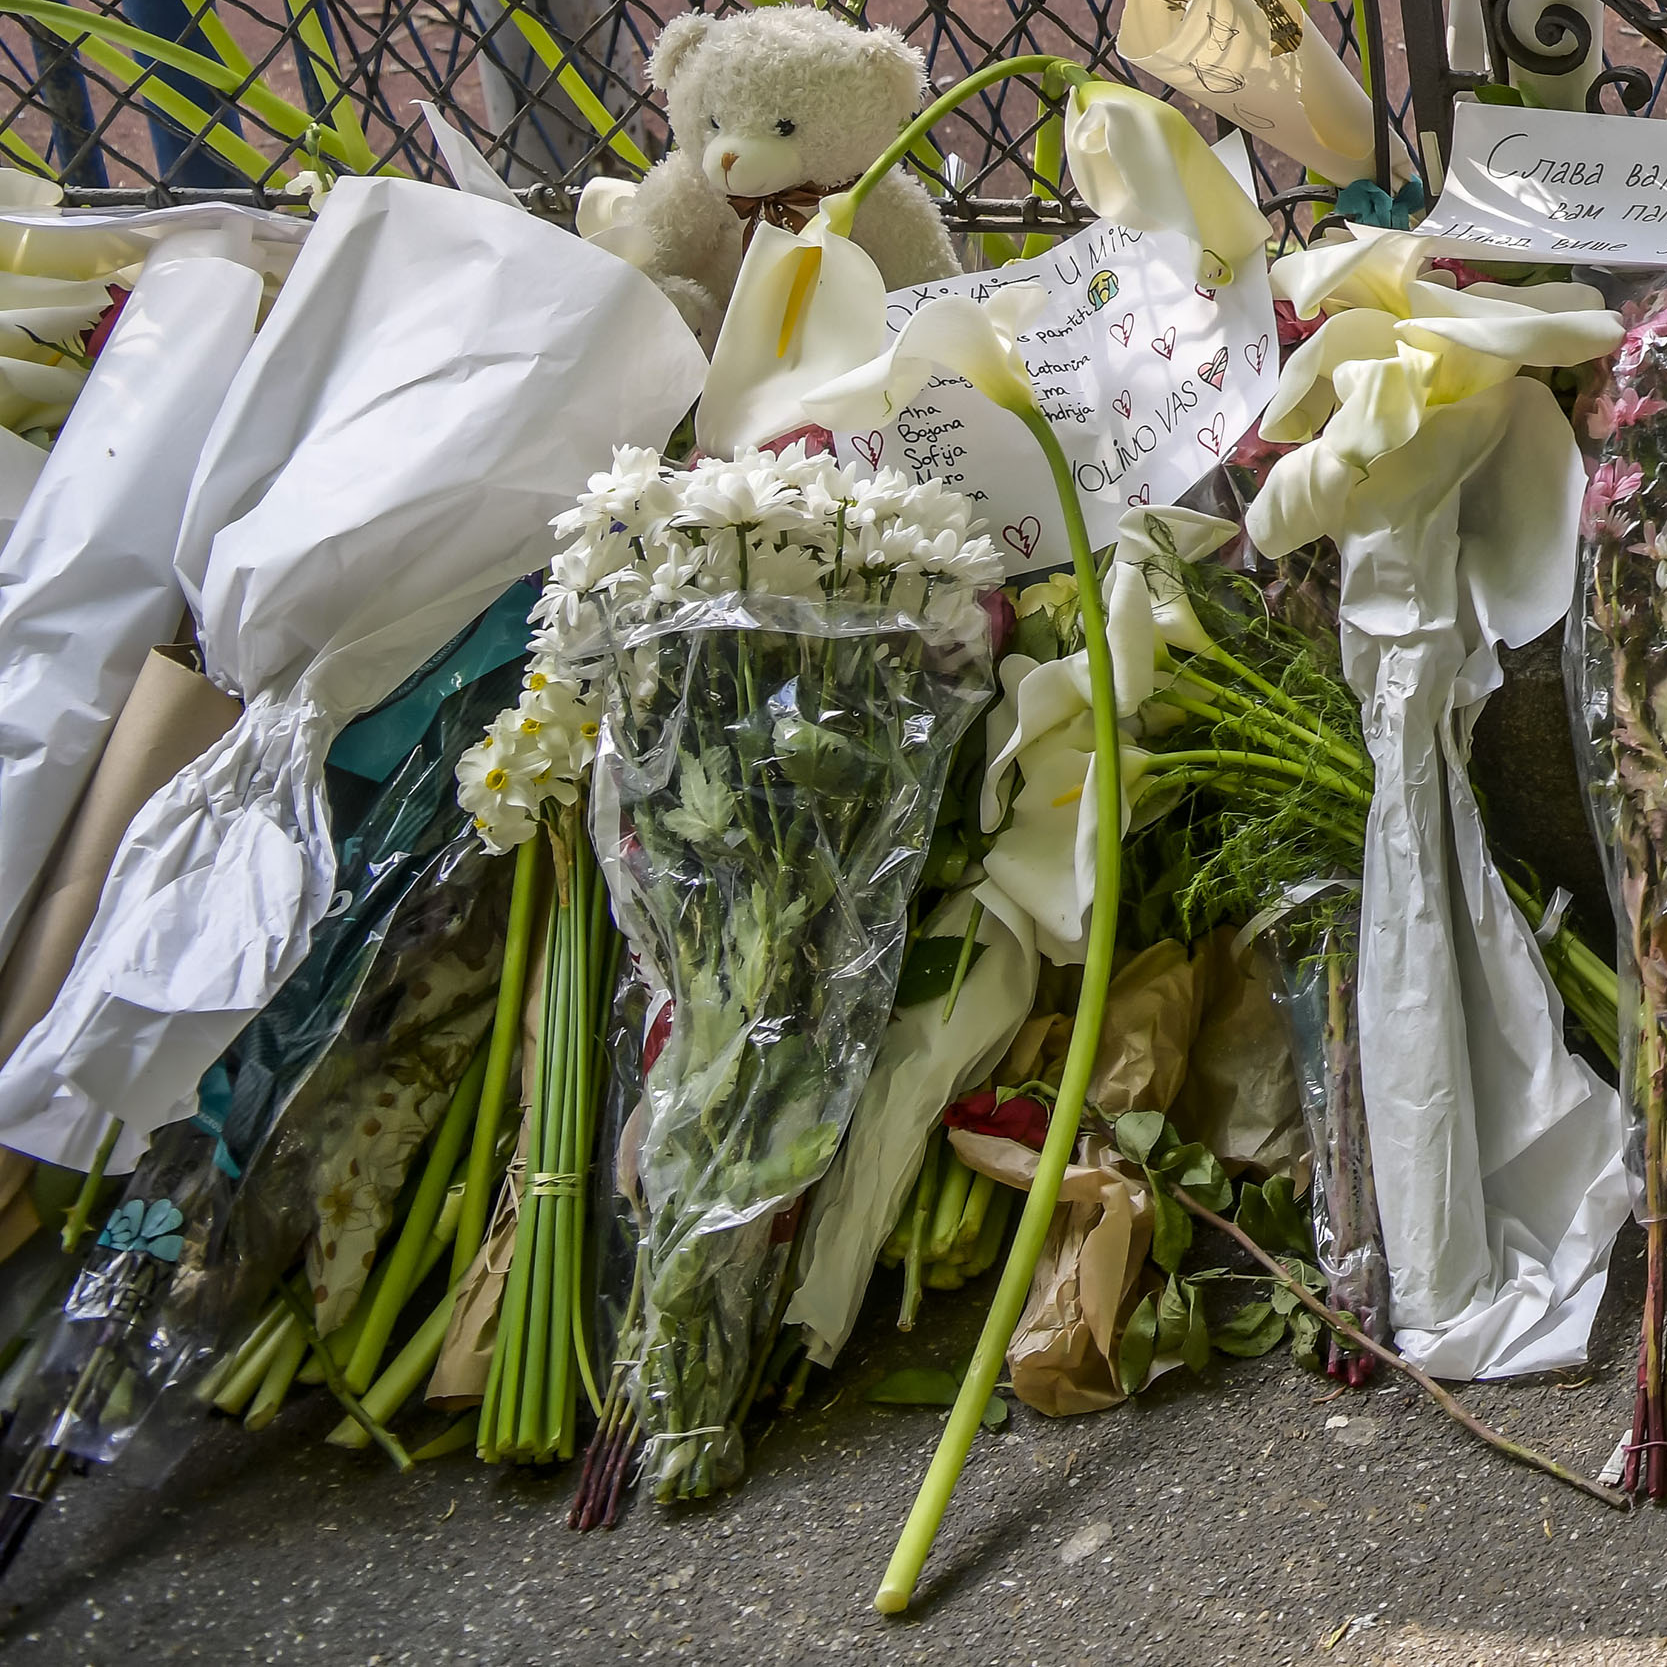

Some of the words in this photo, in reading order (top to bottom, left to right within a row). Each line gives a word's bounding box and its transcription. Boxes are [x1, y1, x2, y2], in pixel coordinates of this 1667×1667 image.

[1487, 133, 1604, 185] Слава
[1548, 201, 1606, 221] вам
[1550, 237, 1629, 253] више
[1035, 305, 1094, 345] pamtiti
[1155, 380, 1198, 434] VAS
[897, 419, 965, 443] Bojana
[904, 444, 967, 470] Sofija
